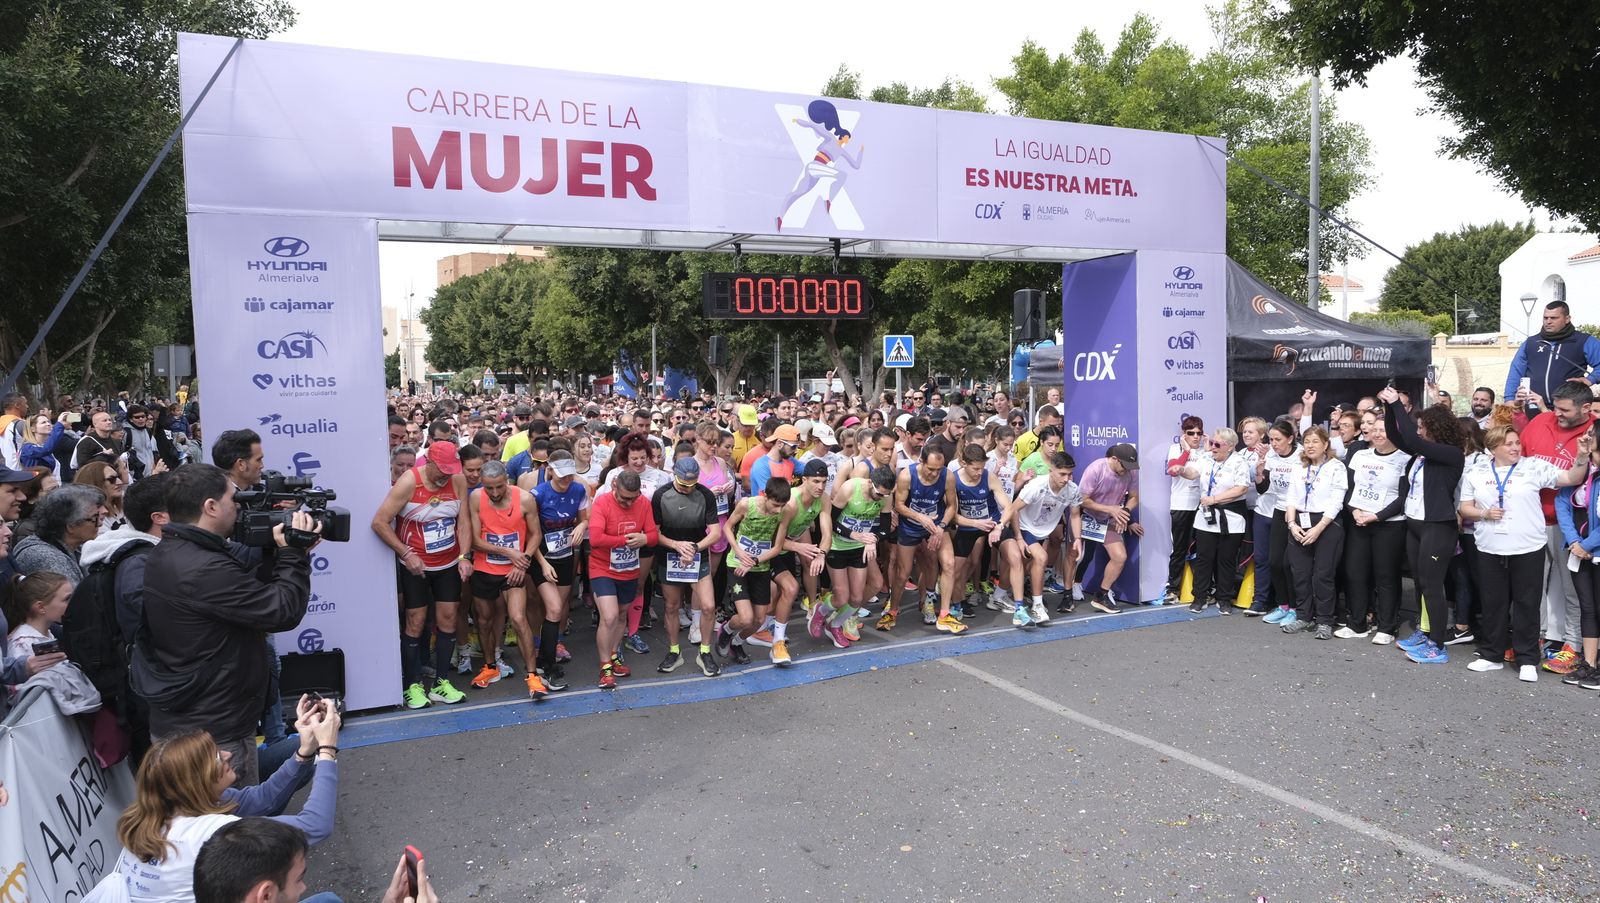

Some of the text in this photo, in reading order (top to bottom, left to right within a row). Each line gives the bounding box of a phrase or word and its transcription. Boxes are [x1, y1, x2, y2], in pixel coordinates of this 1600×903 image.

[407, 87, 641, 130] CARRERA DE LA
[995, 137, 1112, 166] LA IGUALDAD
[392, 125, 657, 201] MUJER
[965, 167, 1138, 198] ES NUESTRA META.
[975, 201, 1005, 220] CDX
[1036, 205, 1069, 216] ALMERÍA
[247, 260, 328, 271] HYUNDAI
[258, 273, 319, 283] Almerialva
[1165, 282, 1202, 290] HYUNDAI
[1169, 290, 1199, 298] Almerialva
[269, 298, 335, 314] cajamar
[1174, 308, 1206, 318] cajamar
[257, 339, 313, 360] CASI
[1167, 336, 1195, 350] CASI
[1074, 344, 1122, 382] CDX
[1176, 359, 1205, 370] vithas
[279, 374, 337, 389] vithas
[1171, 390, 1204, 403] aqualia
[271, 418, 338, 438] aqualia
[1086, 424, 1129, 438] ALMERÍA
[1086, 438, 1108, 447] CIUDAD
[1358, 488, 1380, 501] 1359
[435, 527, 448, 538] 77
[1086, 523, 1101, 531] 232
